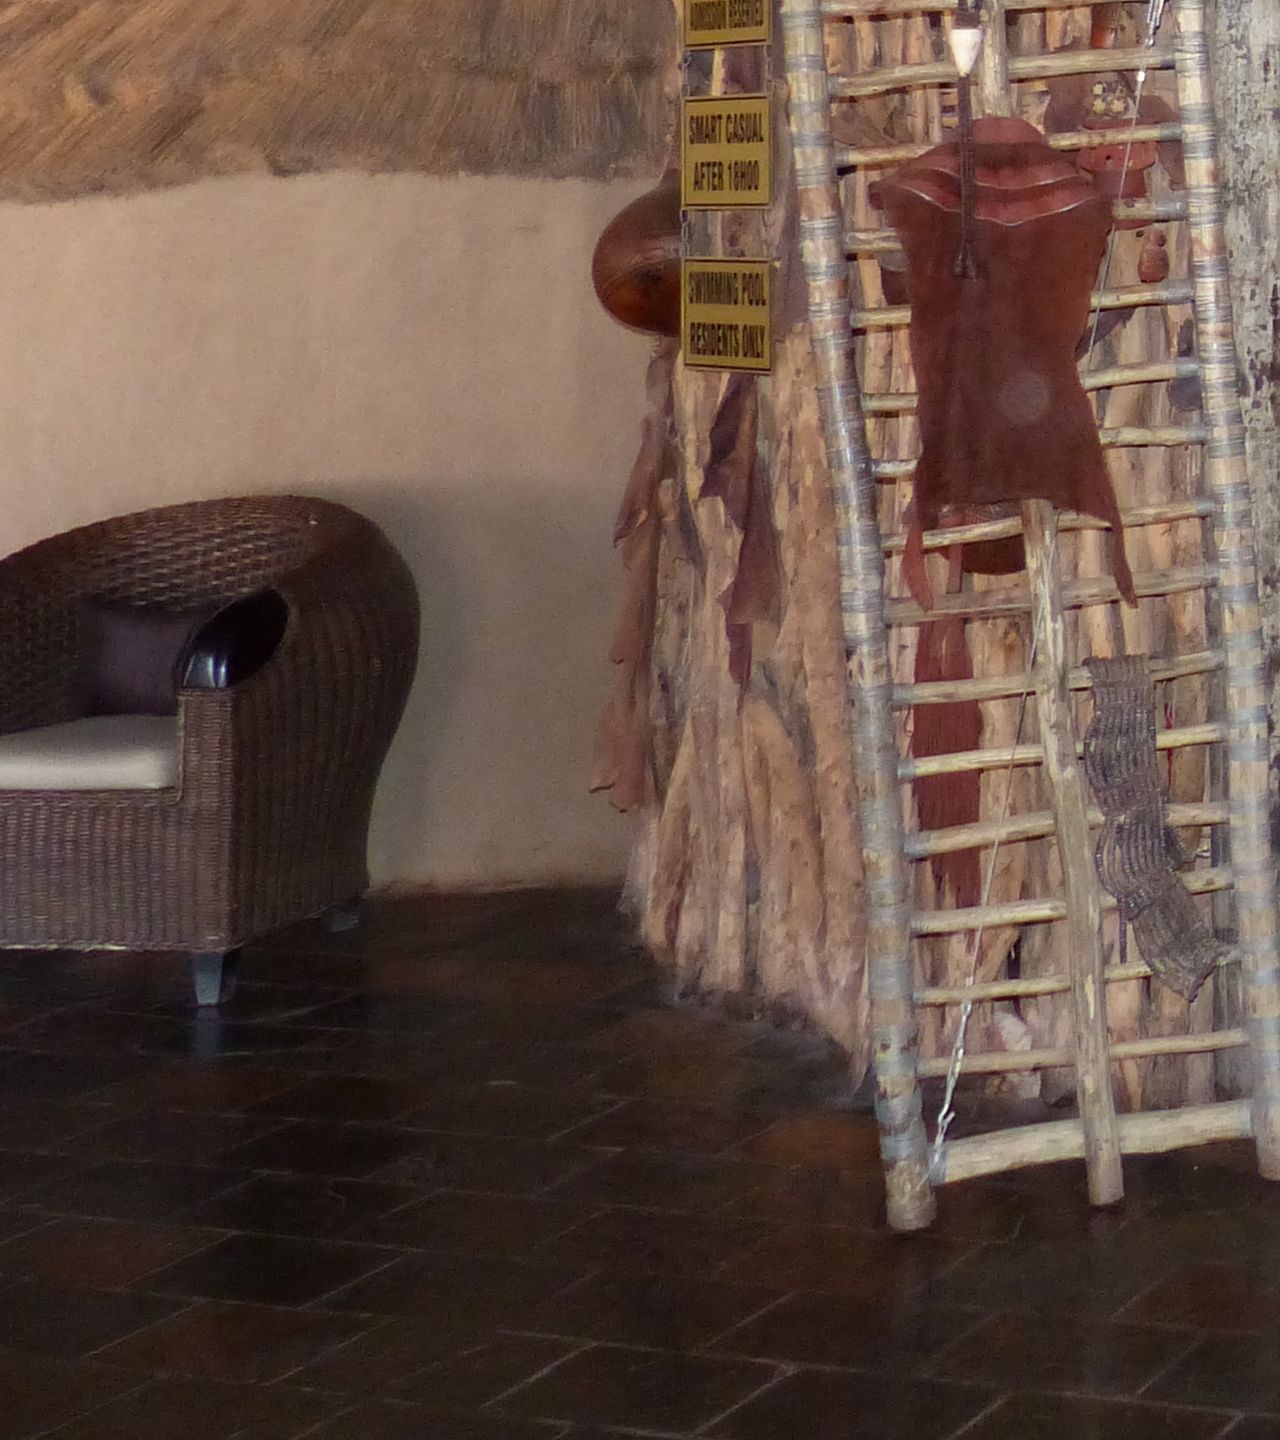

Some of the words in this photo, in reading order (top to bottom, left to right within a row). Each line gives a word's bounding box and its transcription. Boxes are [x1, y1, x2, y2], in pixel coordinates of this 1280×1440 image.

[690, 0, 727, 31] ADMISSION
[689, 113, 723, 144] SMART
[726, 112, 764, 144] CASUAL
[693, 161, 724, 191] AFTER
[728, 160, 760, 191] 18H00
[689, 271, 738, 305] SWIMMING
[742, 272, 766, 306] POOL
[690, 322, 740, 357] RESIDENTS
[742, 324, 766, 358] ONLY
